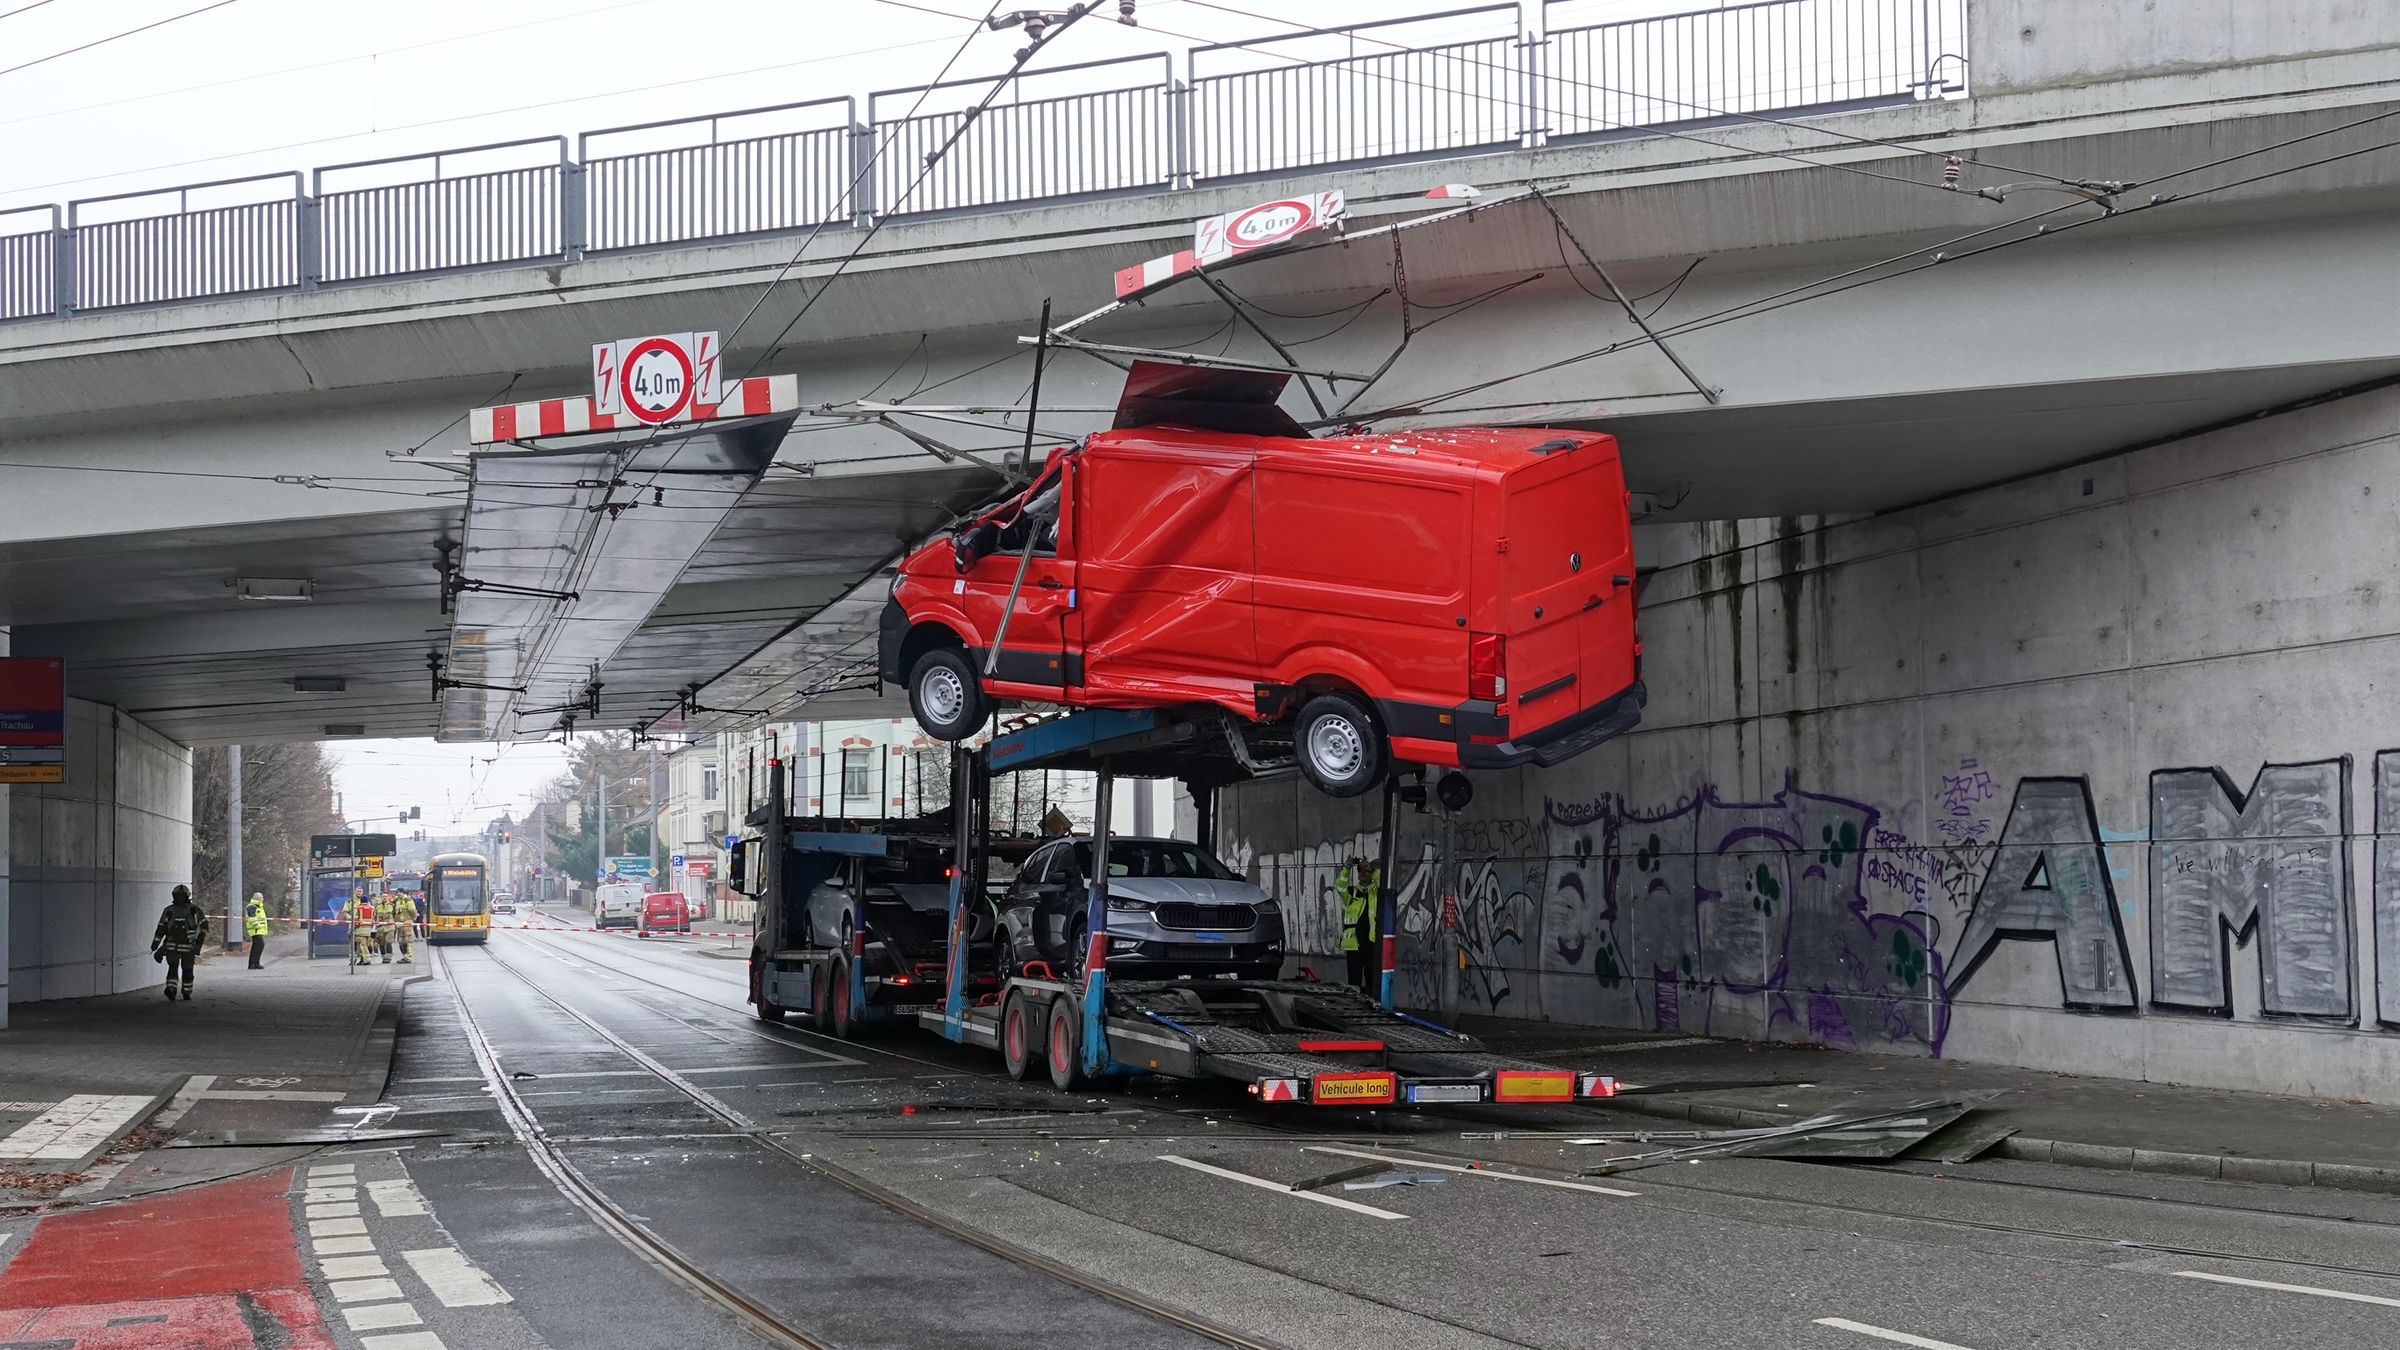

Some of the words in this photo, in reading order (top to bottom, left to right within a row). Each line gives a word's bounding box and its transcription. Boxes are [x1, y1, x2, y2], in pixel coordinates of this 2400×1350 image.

[1, 721, 34, 730] Trachau
[1321, 1082, 1364, 1095] Vehicule
[1366, 1082, 1389, 1096] long
